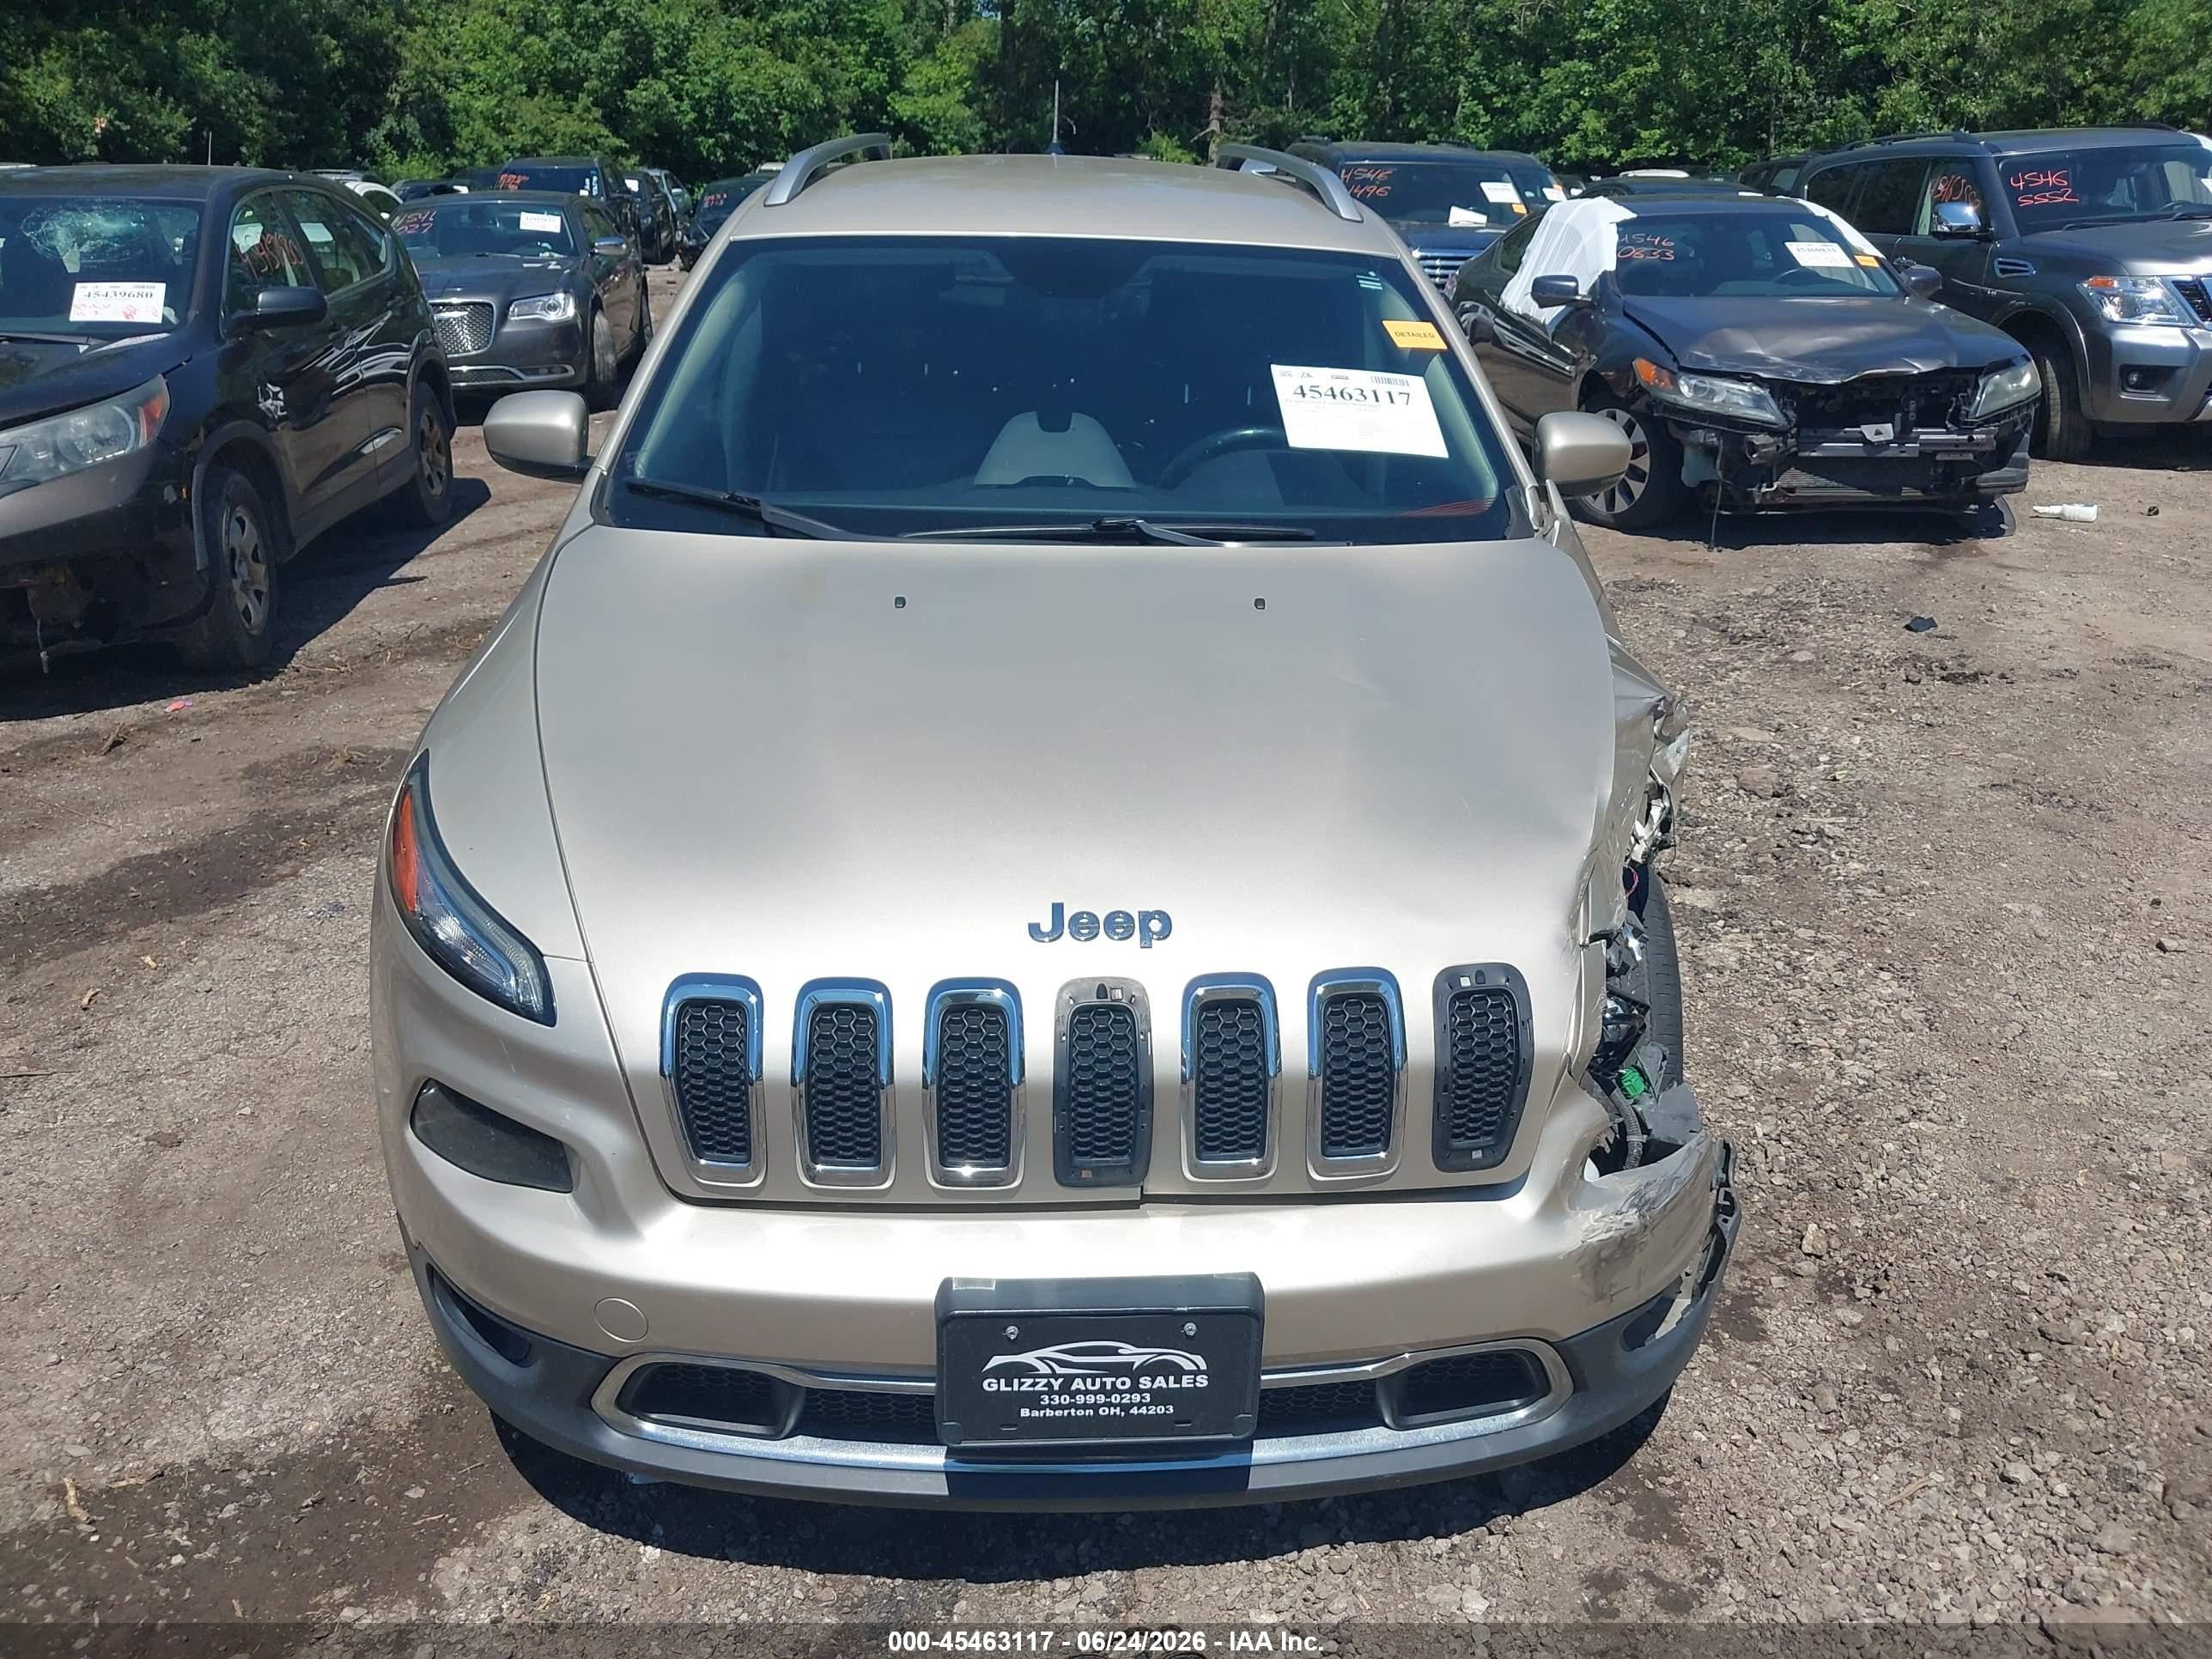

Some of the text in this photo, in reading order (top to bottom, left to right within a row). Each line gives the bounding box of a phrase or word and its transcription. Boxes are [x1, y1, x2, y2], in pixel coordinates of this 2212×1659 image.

[2010, 170, 2068, 190] 4546
[2018, 188, 2079, 207] 5552
[1293, 384, 1411, 406] 45463117
[1027, 902, 1173, 949] Jeep
[981, 1374, 1209, 1392] GLIZZY AUTO SALES
[1039, 1393, 1152, 1406] 330-999-0293
[1020, 1405, 1175, 1418] Barberton OH, 44203
